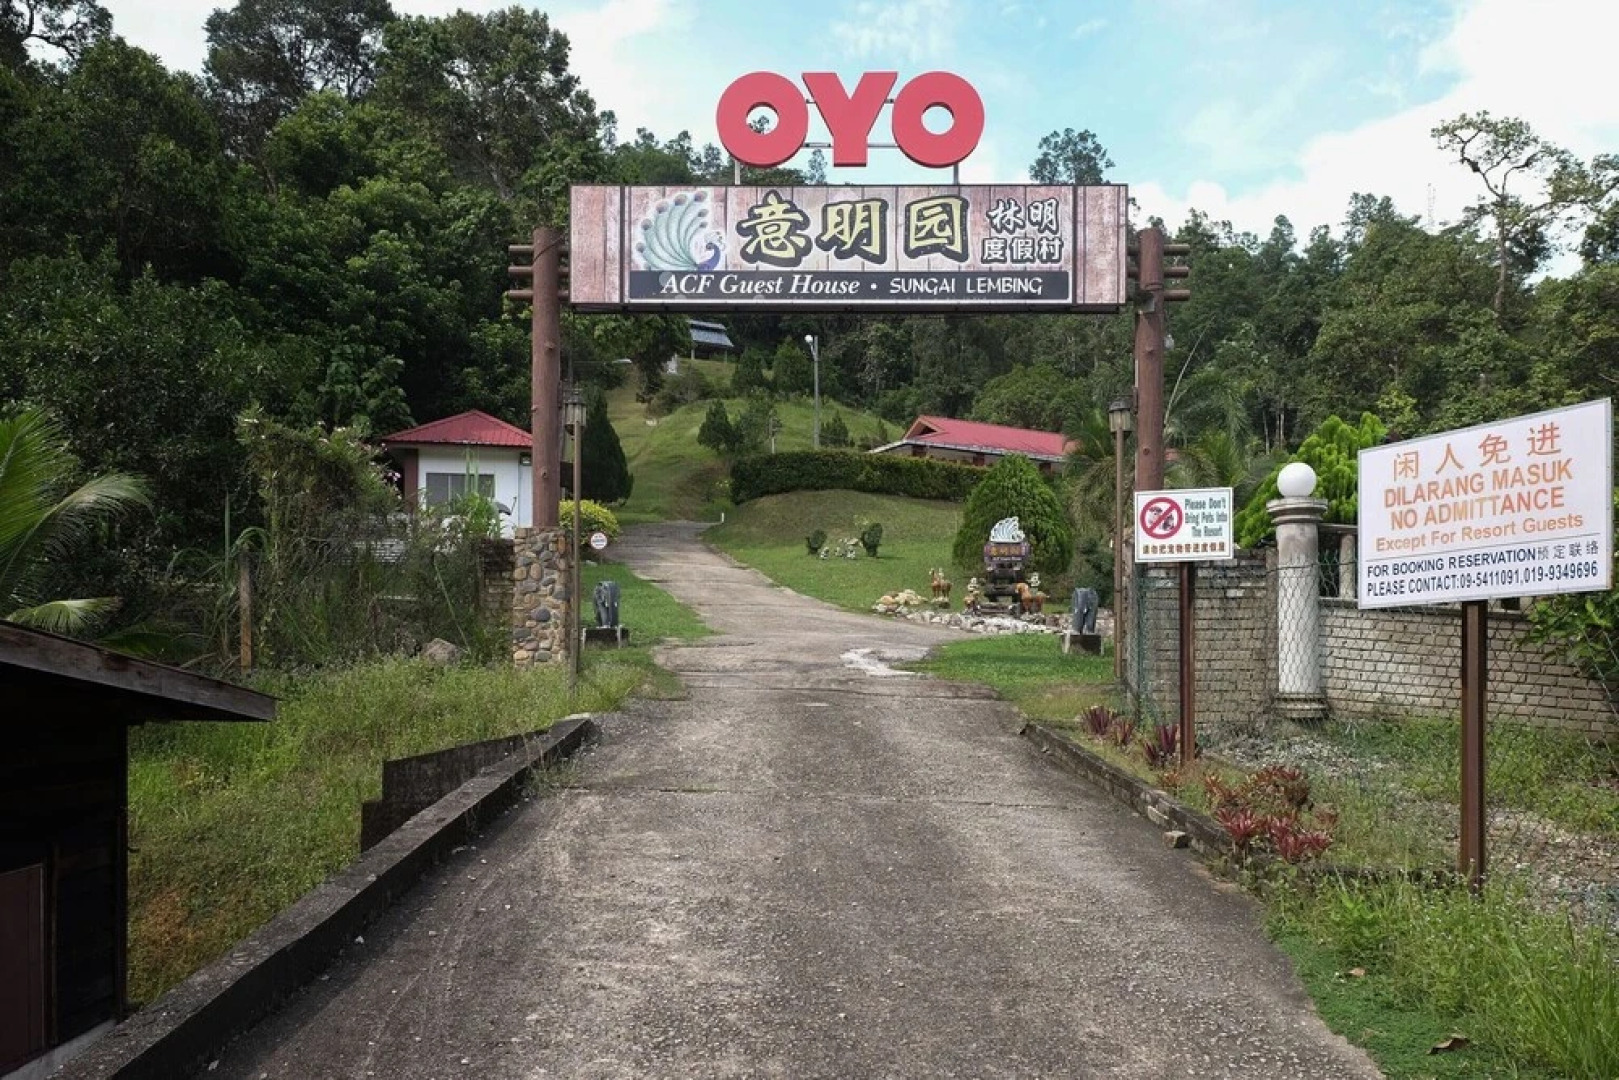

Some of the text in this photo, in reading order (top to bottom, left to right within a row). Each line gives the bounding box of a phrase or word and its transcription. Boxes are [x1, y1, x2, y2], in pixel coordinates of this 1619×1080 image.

[716, 71, 985, 168] OYO
[736, 189, 970, 268] 意明园
[986, 198, 1060, 235] 林明
[981, 236, 1064, 264] 度假村
[660, 274, 1043, 295] ACF Guest House SUNGAI LEMBING
[1393, 421, 1562, 481] 闲人免进
[1384, 458, 1573, 508] DILARANG MASUK
[1391, 487, 1565, 531] NO ADMITTANCE
[1375, 513, 1583, 552] Except For Resort Guests
[1367, 564, 1389, 578] FOR
[1393, 558, 1444, 576] BOOKING
[1448, 548, 1536, 569] RESERVATION
[1367, 580, 1405, 597] PLEASE
